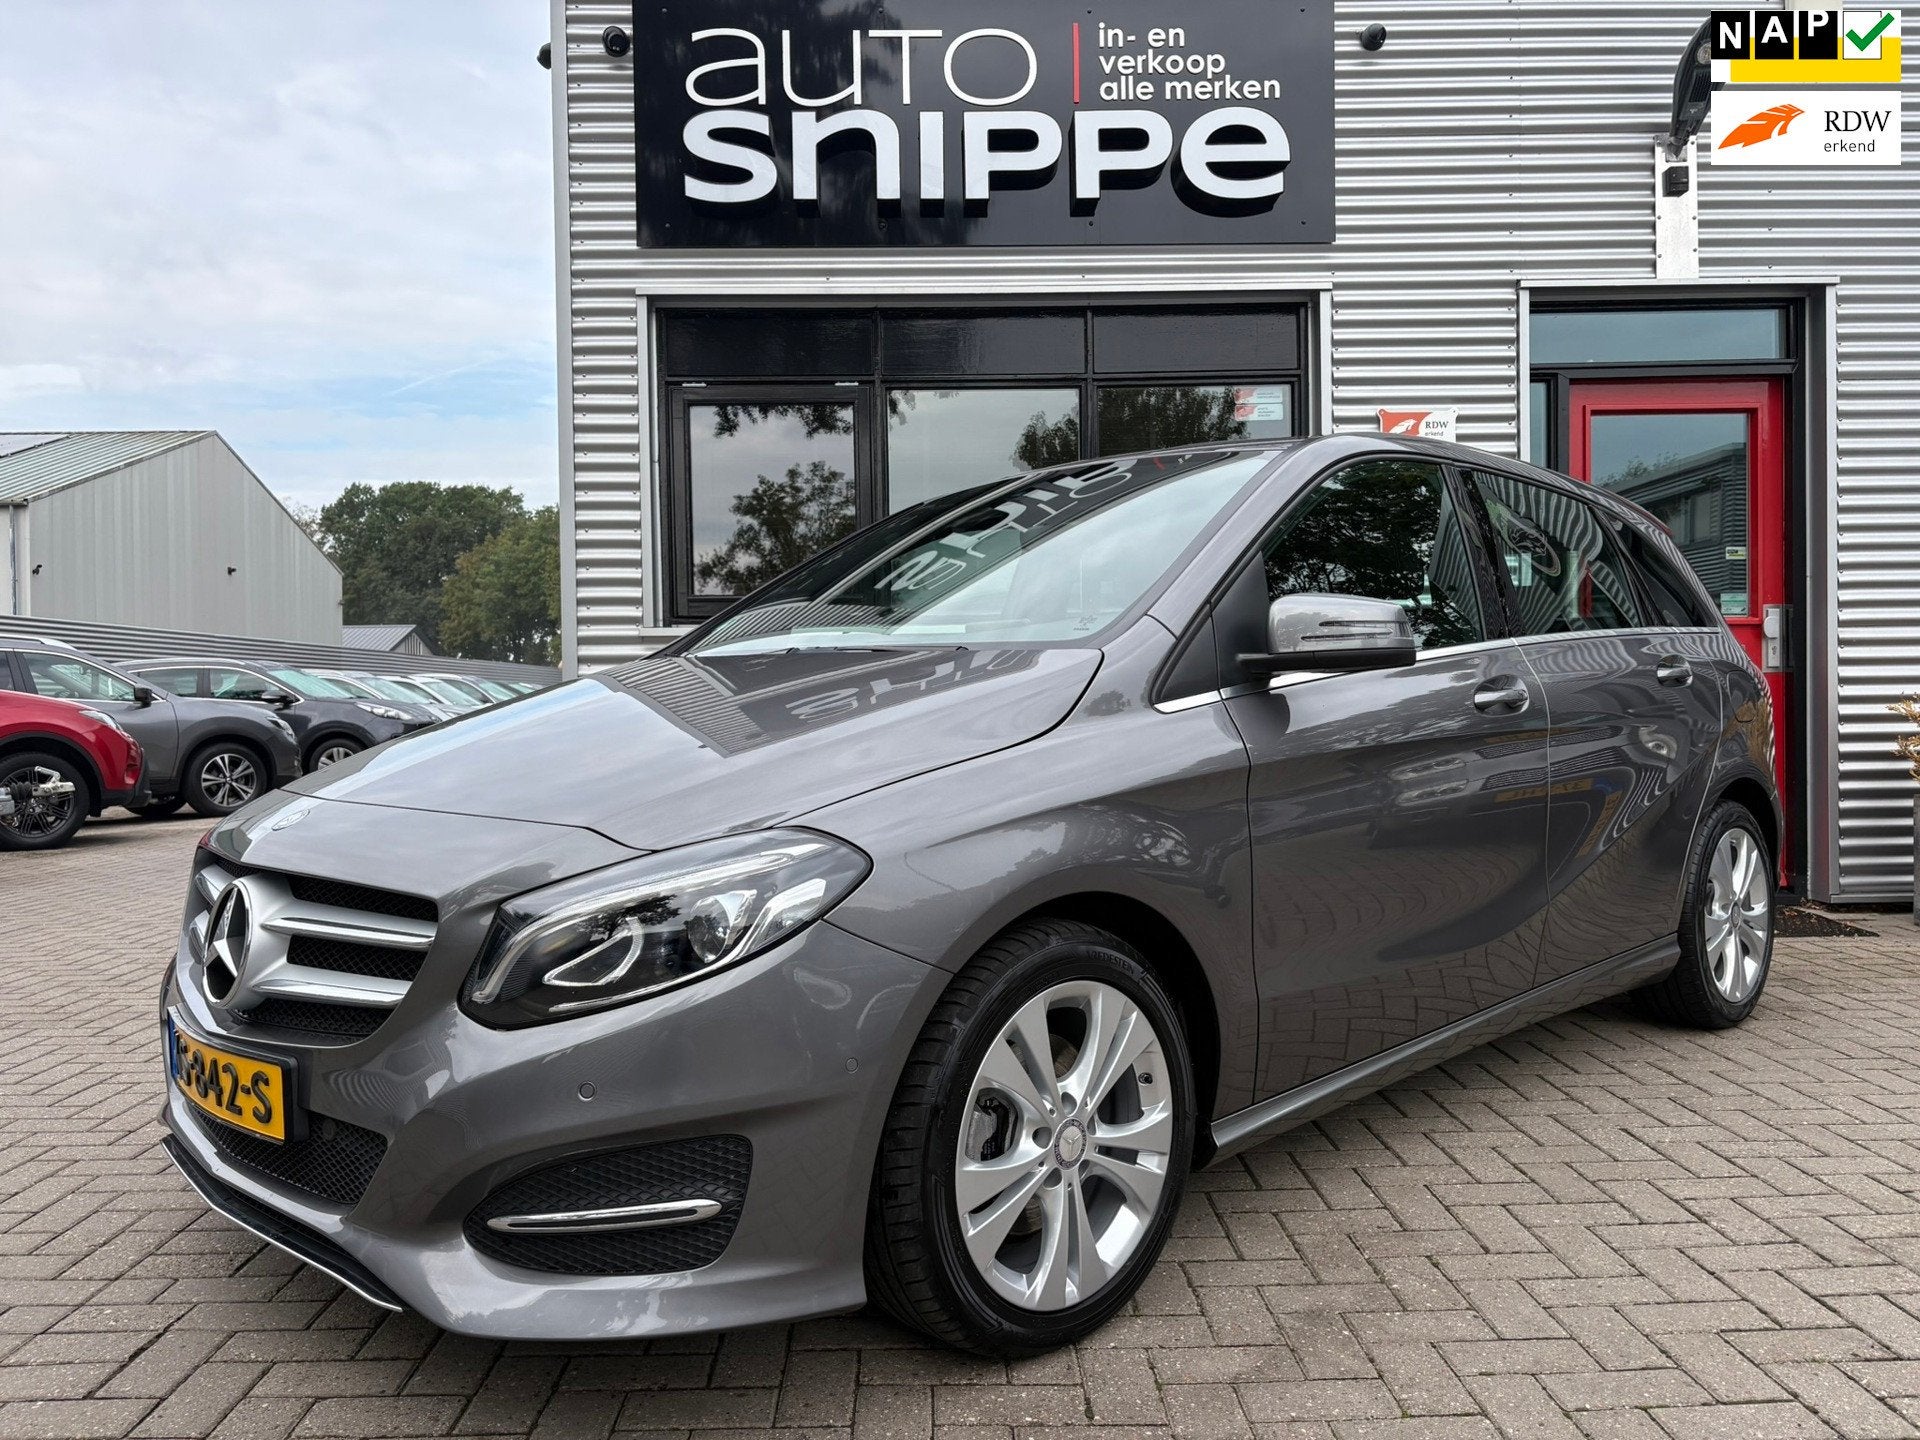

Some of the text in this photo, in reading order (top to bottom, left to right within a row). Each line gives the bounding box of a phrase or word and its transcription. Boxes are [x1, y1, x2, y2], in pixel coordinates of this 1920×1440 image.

[1098, 22, 1185, 48] in- en
[1098, 49, 1226, 79] verkoop
[1099, 74, 1281, 100] alle merken
[1425, 421, 1449, 429] RDW
